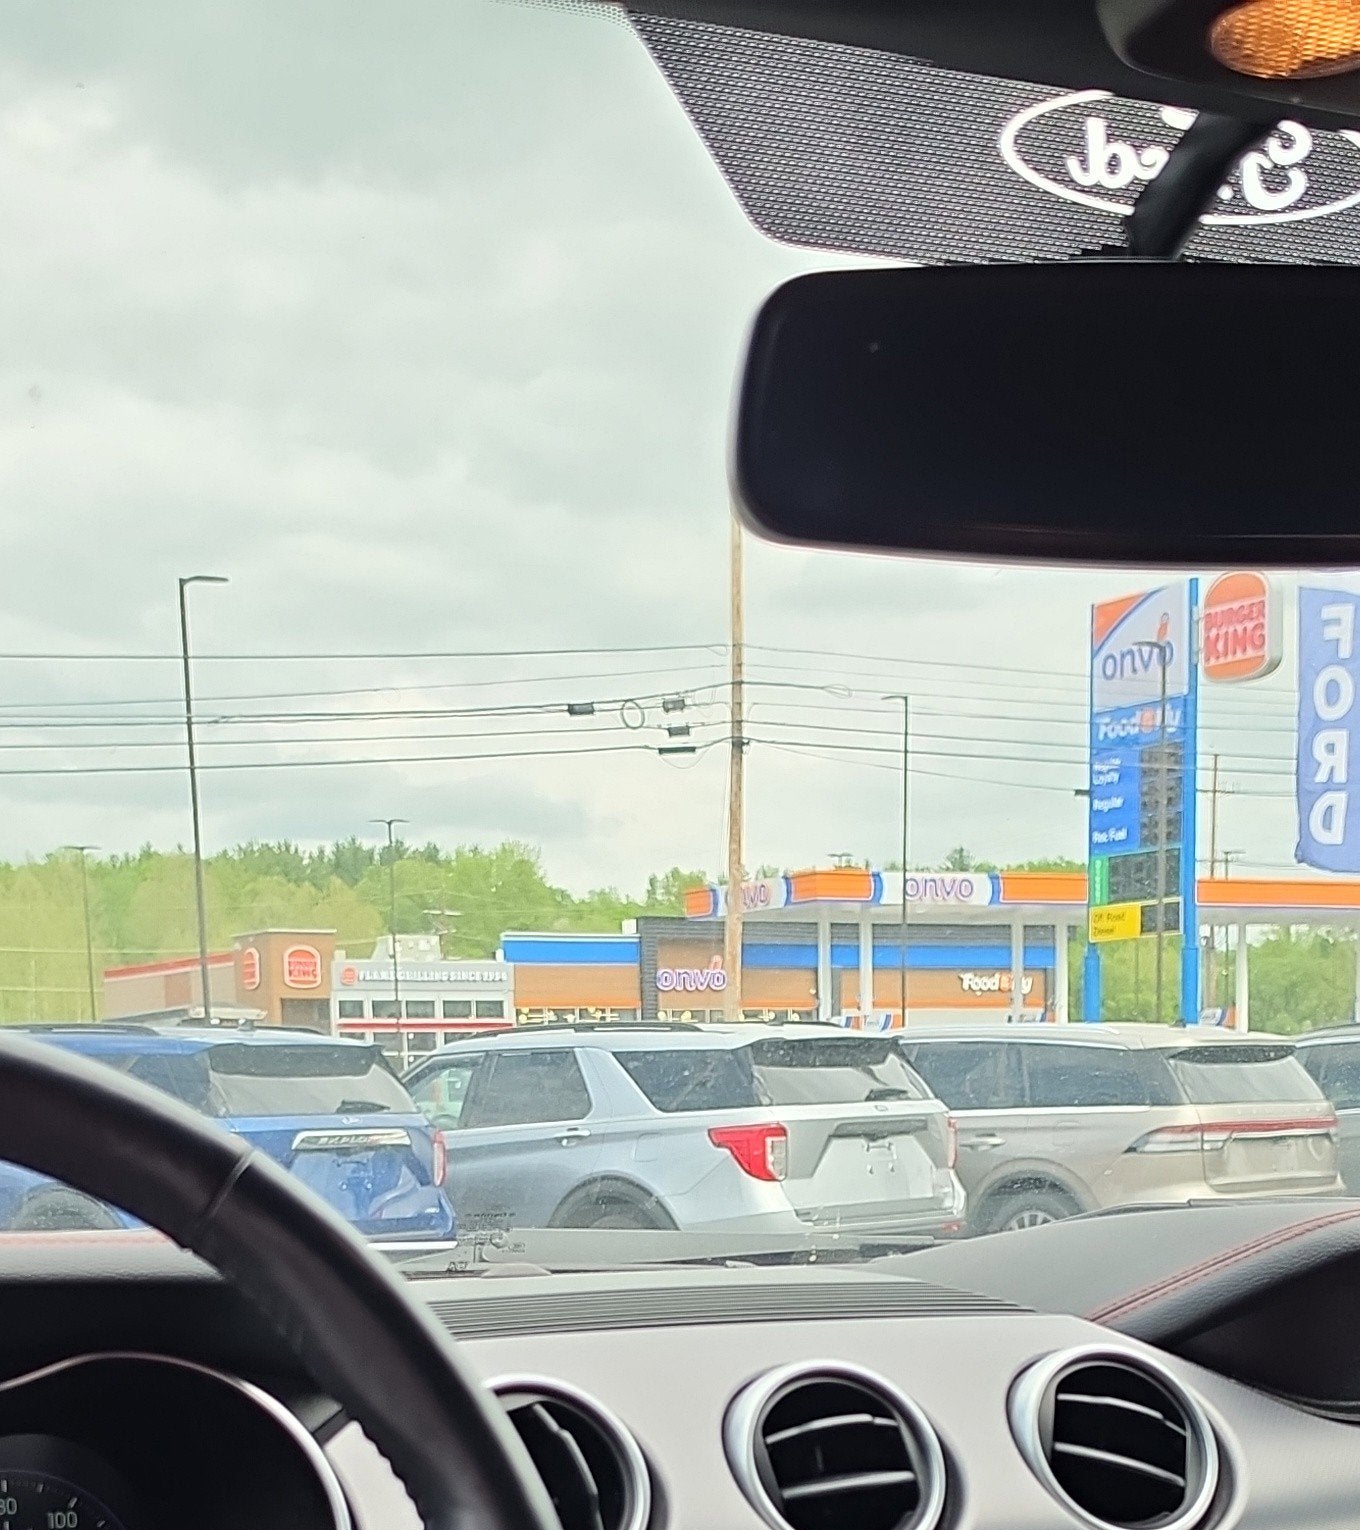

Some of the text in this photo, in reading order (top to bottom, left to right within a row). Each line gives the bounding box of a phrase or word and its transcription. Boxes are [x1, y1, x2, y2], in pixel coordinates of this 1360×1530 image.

[1205, 622, 1266, 662] KING
[905, 875, 975, 900] onvo
[656, 967, 728, 991] onvo
[47, 1510, 78, 1530] 100
